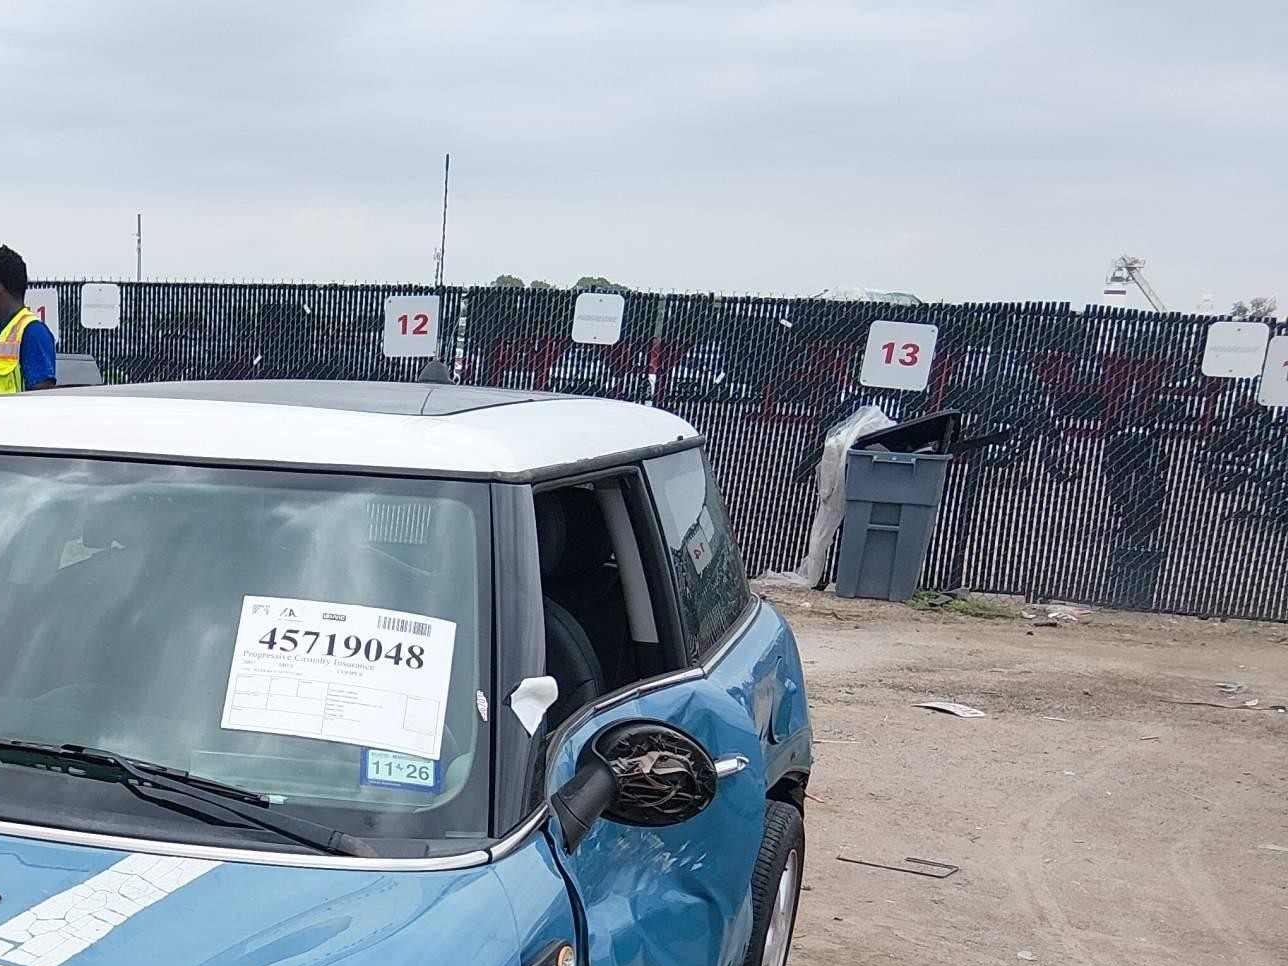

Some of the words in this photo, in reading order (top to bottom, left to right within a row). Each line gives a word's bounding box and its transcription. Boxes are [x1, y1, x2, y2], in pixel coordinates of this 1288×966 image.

[397, 313, 429, 336] 12
[881, 342, 920, 367] 13
[258, 627, 425, 670] 45719048
[243, 650, 293, 661] Progressive
[294, 654, 330, 666] Casualty
[333, 660, 375, 671] Insurance
[372, 760, 393, 776] 11
[406, 763, 430, 781] 26
